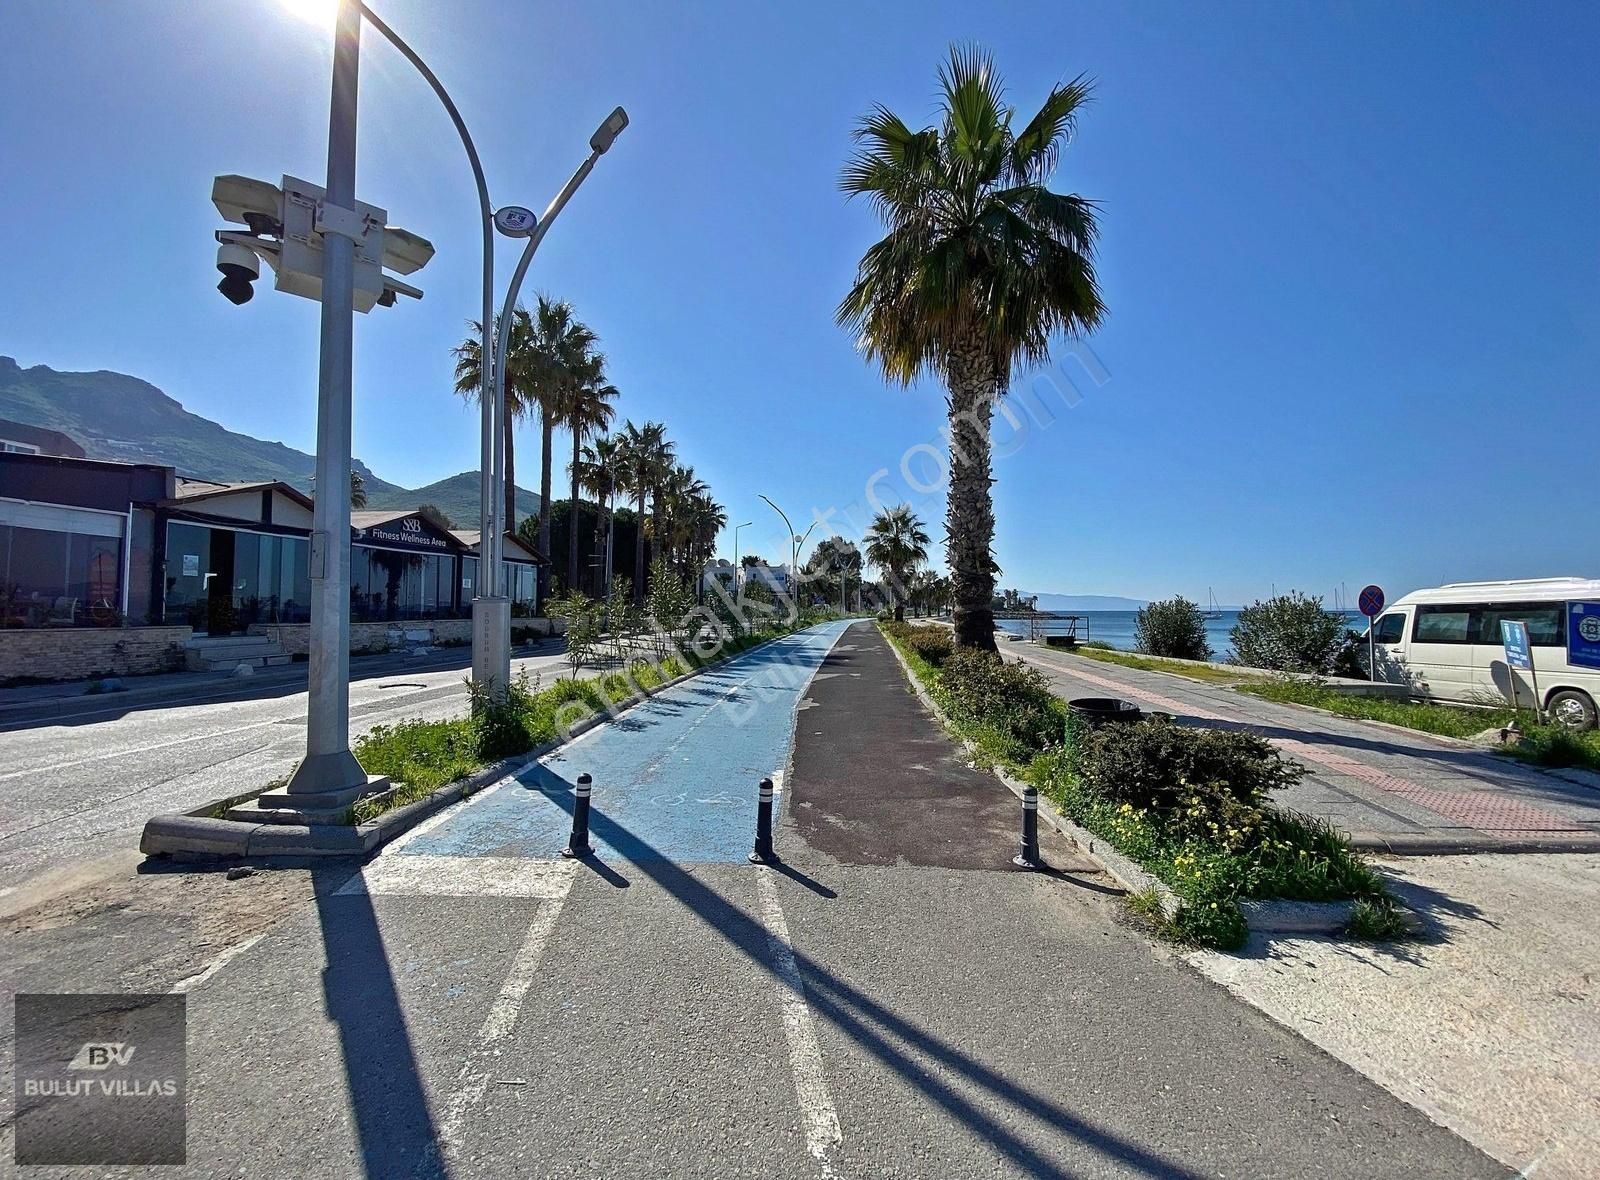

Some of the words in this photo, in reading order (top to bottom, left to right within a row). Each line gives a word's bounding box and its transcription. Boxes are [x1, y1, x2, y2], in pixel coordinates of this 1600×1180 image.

[372, 528, 400, 541] Fitness
[400, 532, 430, 545] Wellness
[431, 537, 446, 547] Area
